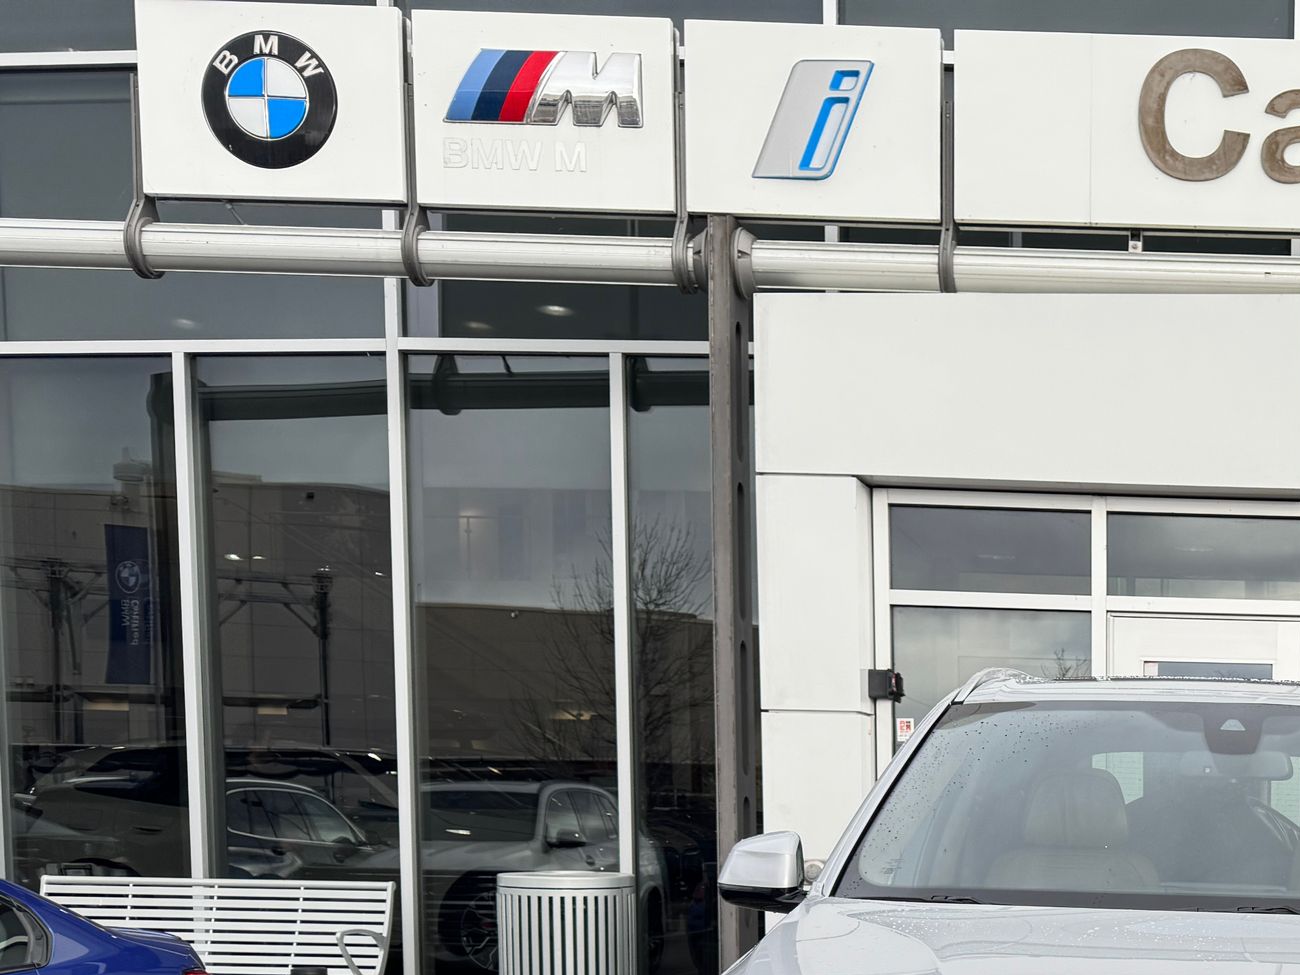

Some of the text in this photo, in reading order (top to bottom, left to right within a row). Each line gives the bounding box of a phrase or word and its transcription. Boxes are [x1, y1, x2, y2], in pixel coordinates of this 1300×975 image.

[212, 33, 325, 80] BMW
[524, 49, 645, 129] M
[442, 136, 589, 173] BMW M
